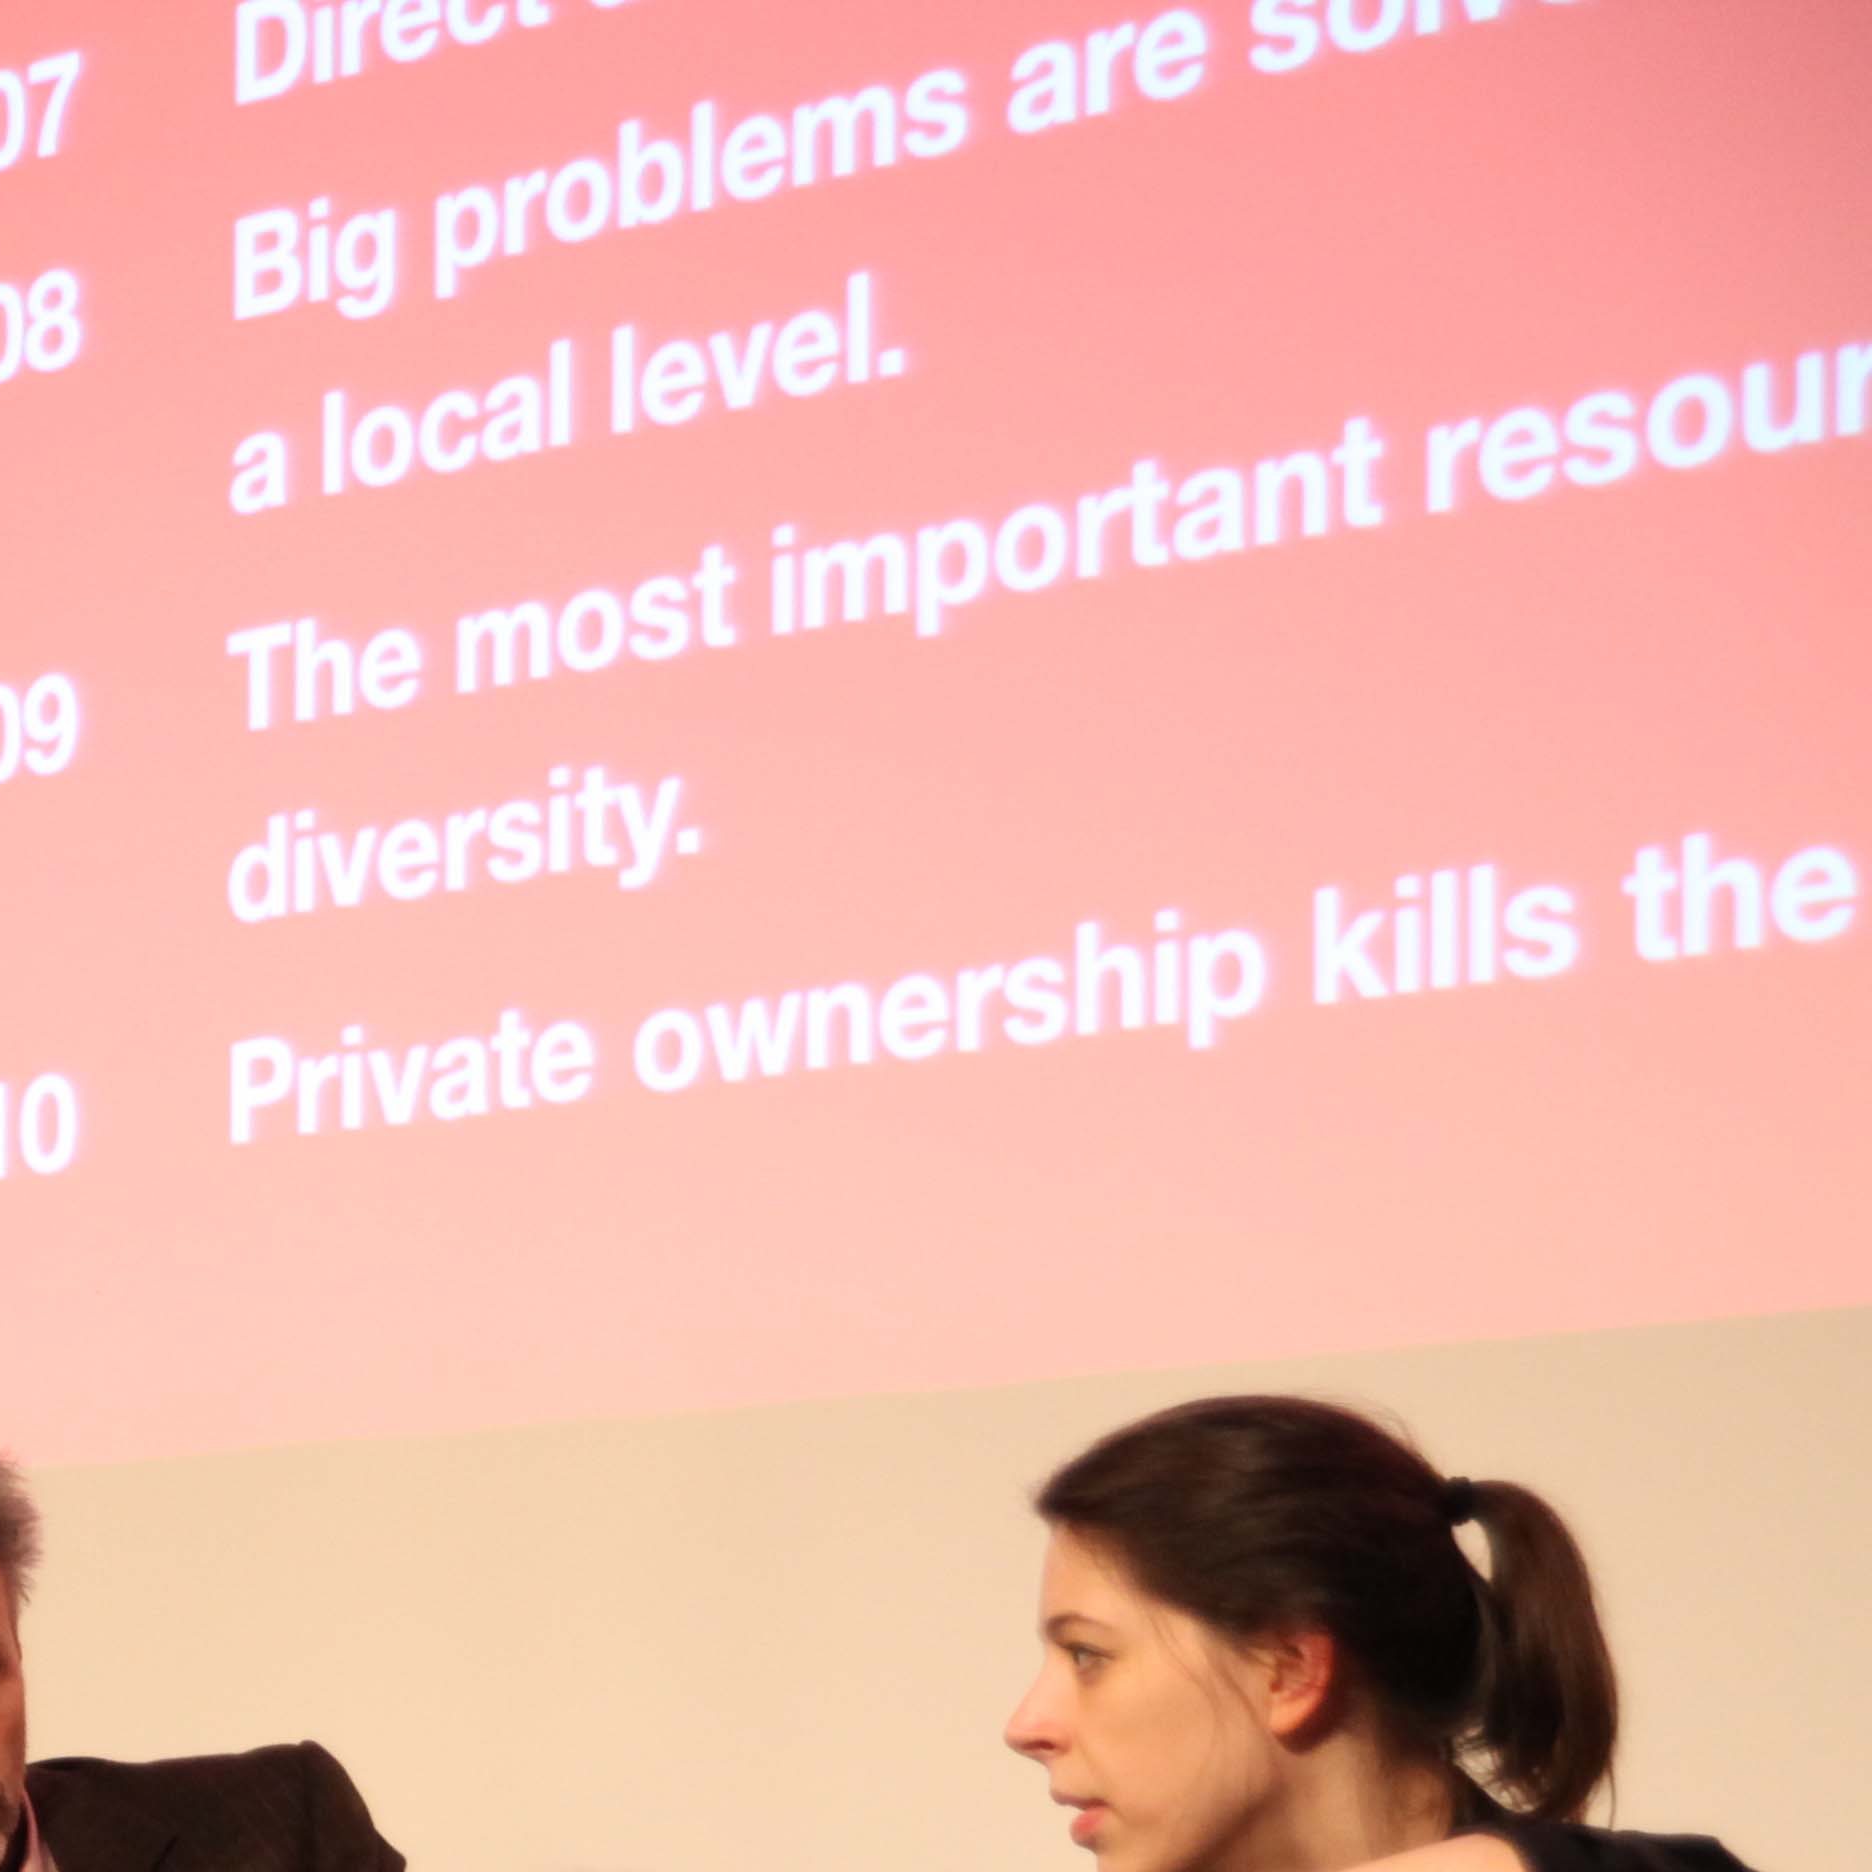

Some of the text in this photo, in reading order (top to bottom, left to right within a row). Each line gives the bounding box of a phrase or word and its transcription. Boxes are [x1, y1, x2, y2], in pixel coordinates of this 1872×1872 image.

[230, 193, 402, 323] Big
[432, 66, 973, 302] problems
[1005, 7, 1211, 136] are
[233, 0, 555, 107] Direc
[226, 268, 910, 518] a local level.
[223, 613, 428, 734] The
[453, 541, 743, 697] most
[768, 414, 1389, 640] important
[224, 761, 706, 926] diversity.
[227, 1005, 602, 1147] Private
[630, 904, 1275, 1096] ownership
[1310, 859, 1584, 1007] kills
[1618, 829, 1863, 963] the
